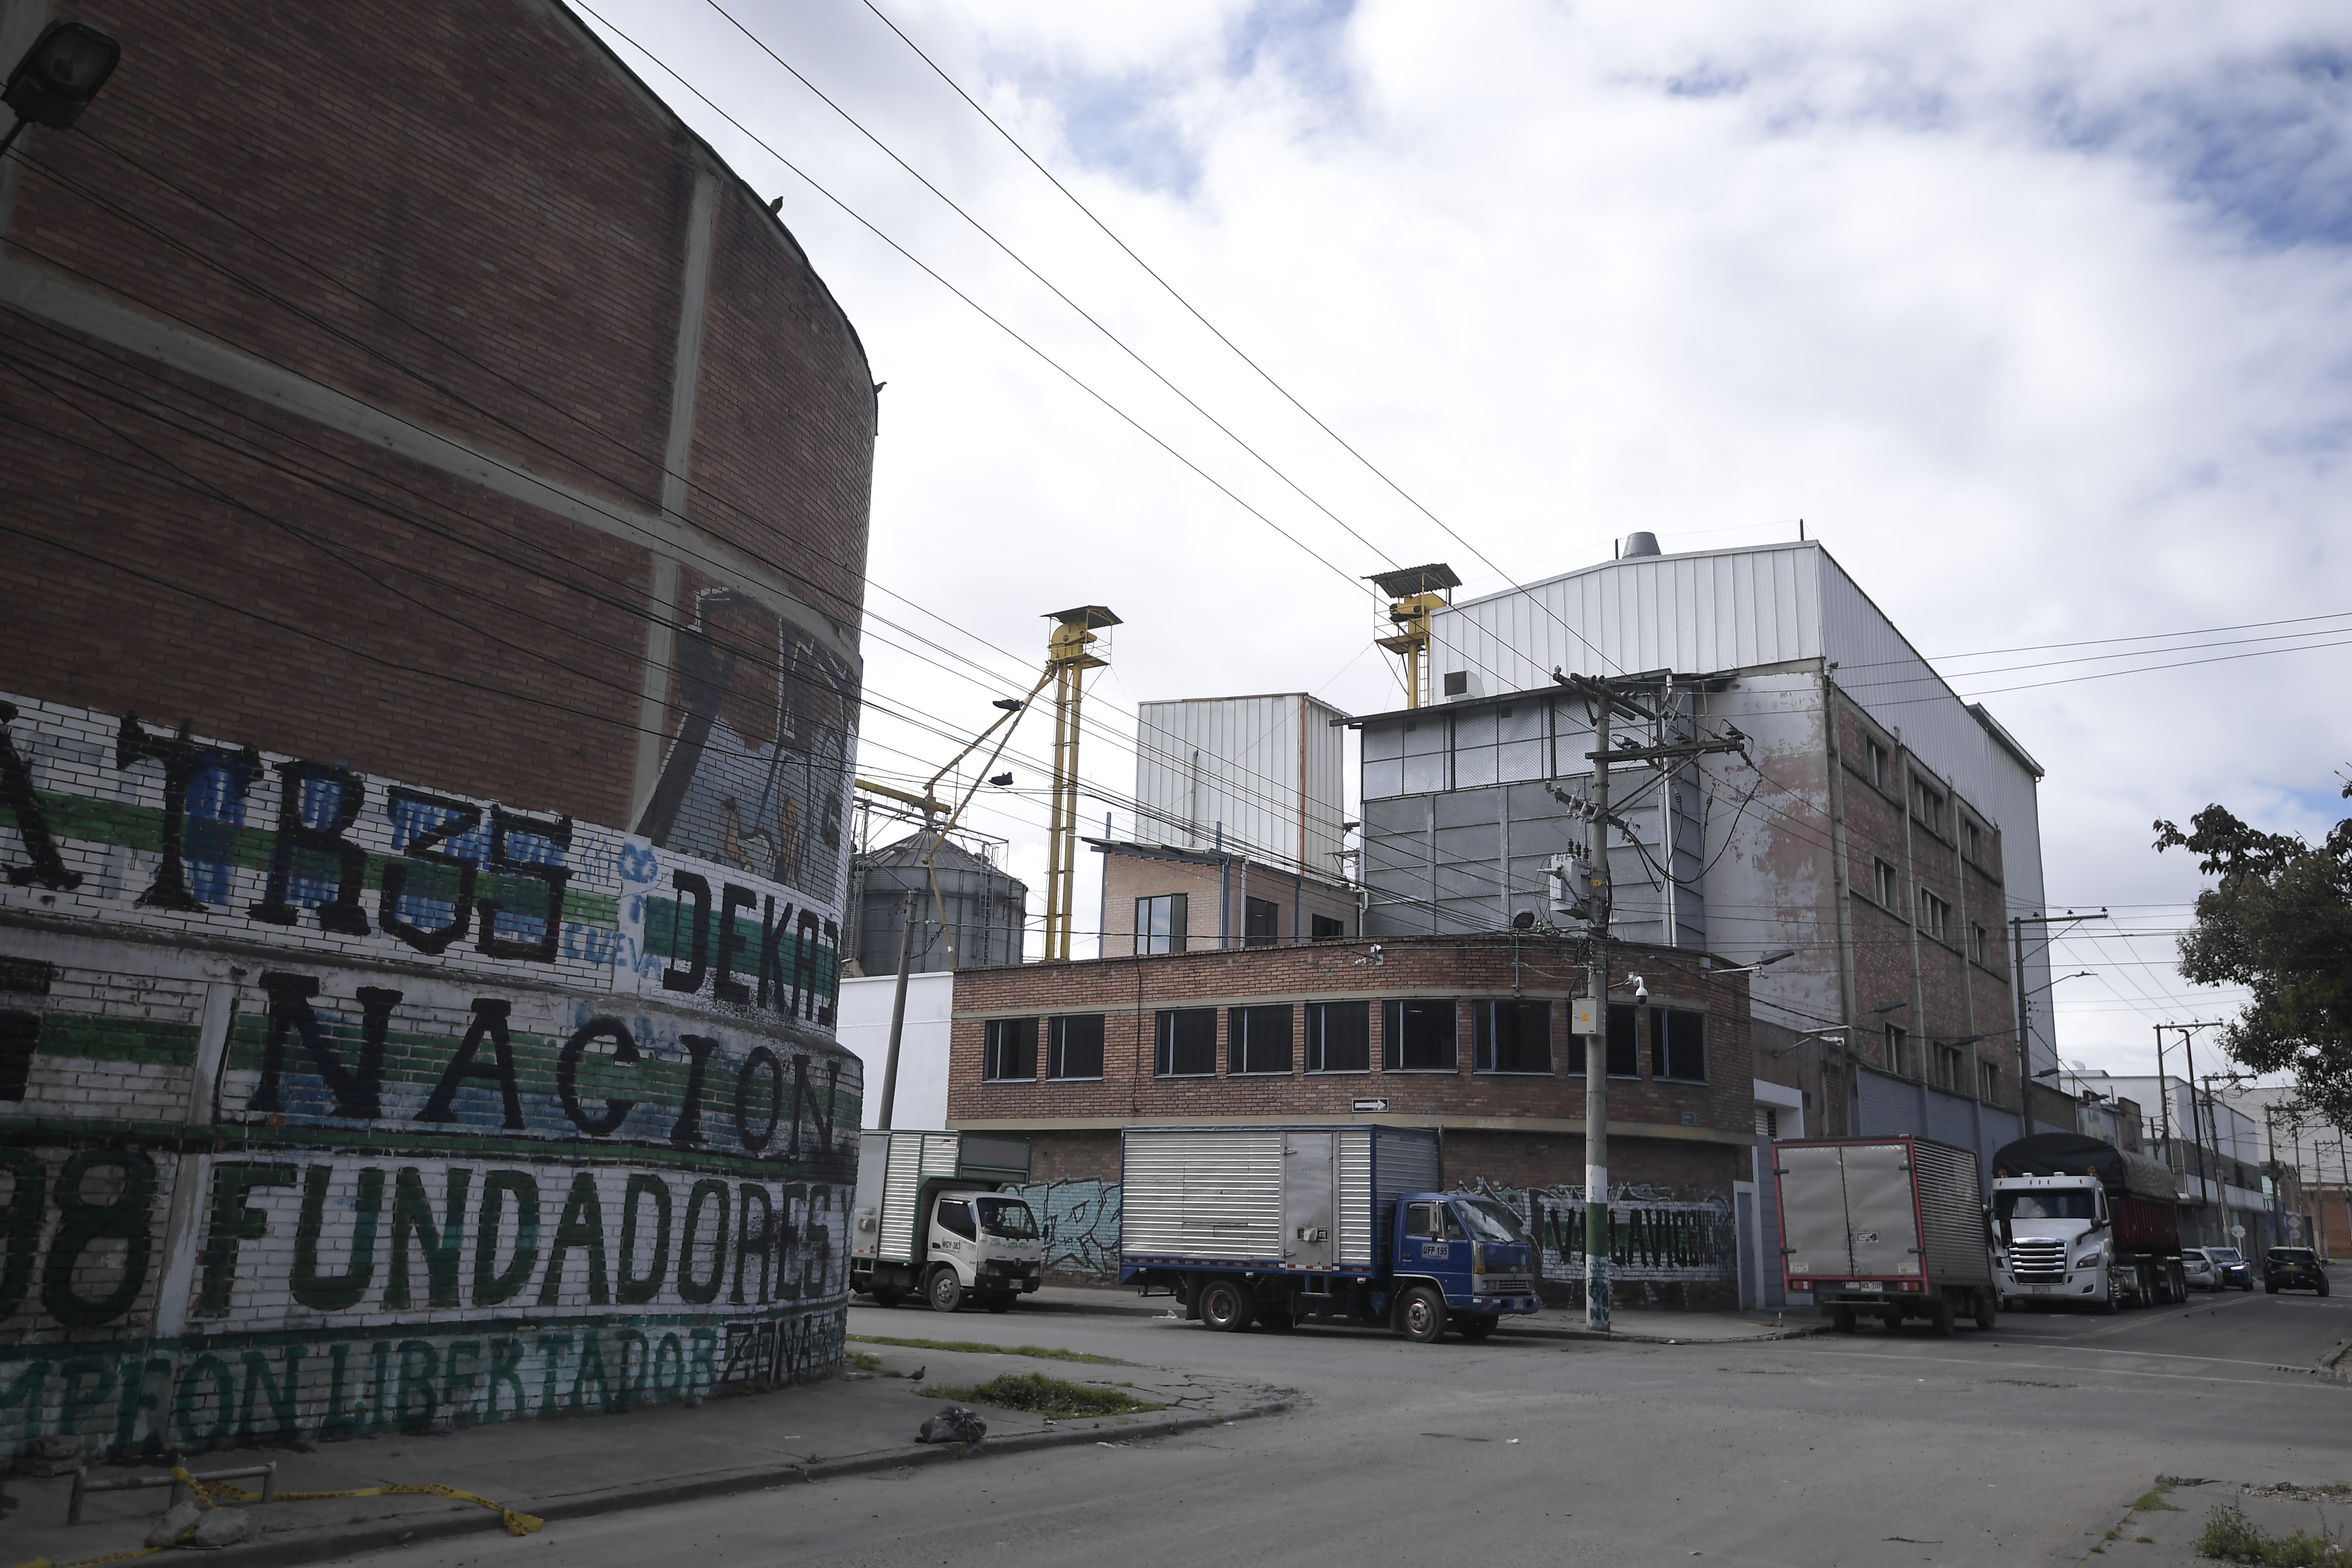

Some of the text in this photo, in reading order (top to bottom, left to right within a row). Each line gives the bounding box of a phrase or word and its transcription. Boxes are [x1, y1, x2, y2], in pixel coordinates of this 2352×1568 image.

[246, 971, 842, 1160] NACION
[192, 1160, 831, 1318] FUNDADORES
[1423, 1246, 1448, 1255] UFP 195
